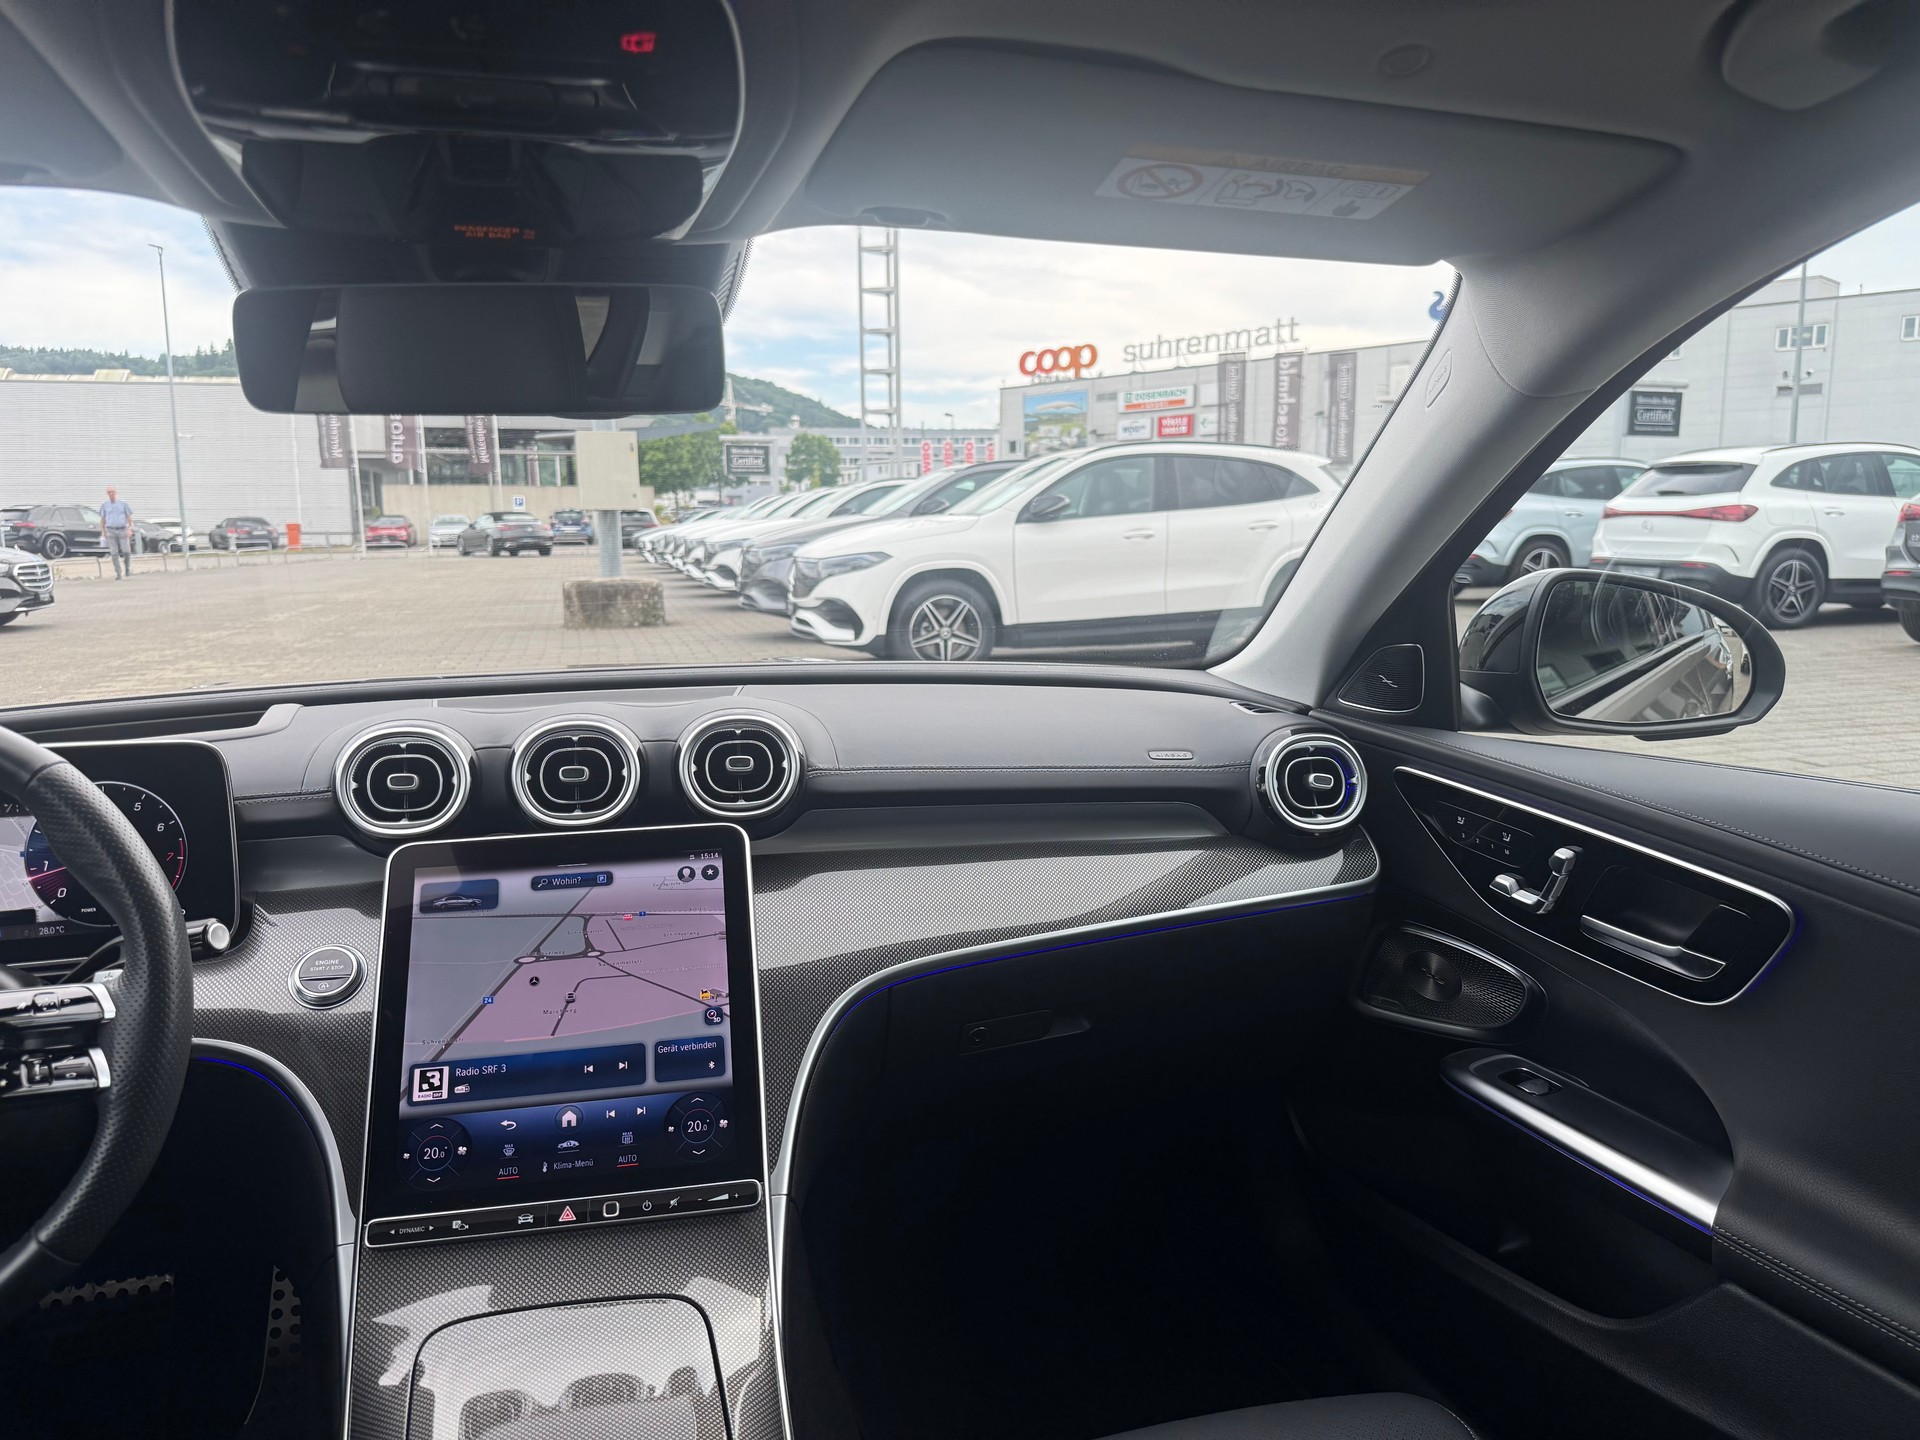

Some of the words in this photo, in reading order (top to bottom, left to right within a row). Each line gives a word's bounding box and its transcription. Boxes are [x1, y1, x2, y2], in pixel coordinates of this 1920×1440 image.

[453, 225, 520, 234] PASSENGER
[1123, 317, 1300, 364] suhrenmatt
[1019, 343, 1098, 379] coop
[134, 802, 142, 811] 5
[157, 823, 165, 832] 6
[166, 852, 174, 861] 7
[700, 852, 719, 860] 15:14
[43, 860, 49, 871] 1
[552, 877, 582, 886] Wohin?
[57, 887, 67, 898] 0
[39, 926, 55, 935] 28.0
[658, 1044, 678, 1054] Gerät
[680, 1041, 717, 1051] verbinden
[455, 1067, 480, 1077] Radio
[482, 1064, 498, 1075] SRF
[501, 1064, 507, 1073] 3
[553, 1158, 594, 1170] Klima-Menü
[618, 1154, 638, 1164] AUTO
[498, 1166, 519, 1176] AUTO
[399, 1226, 426, 1235] DYNAMIC
